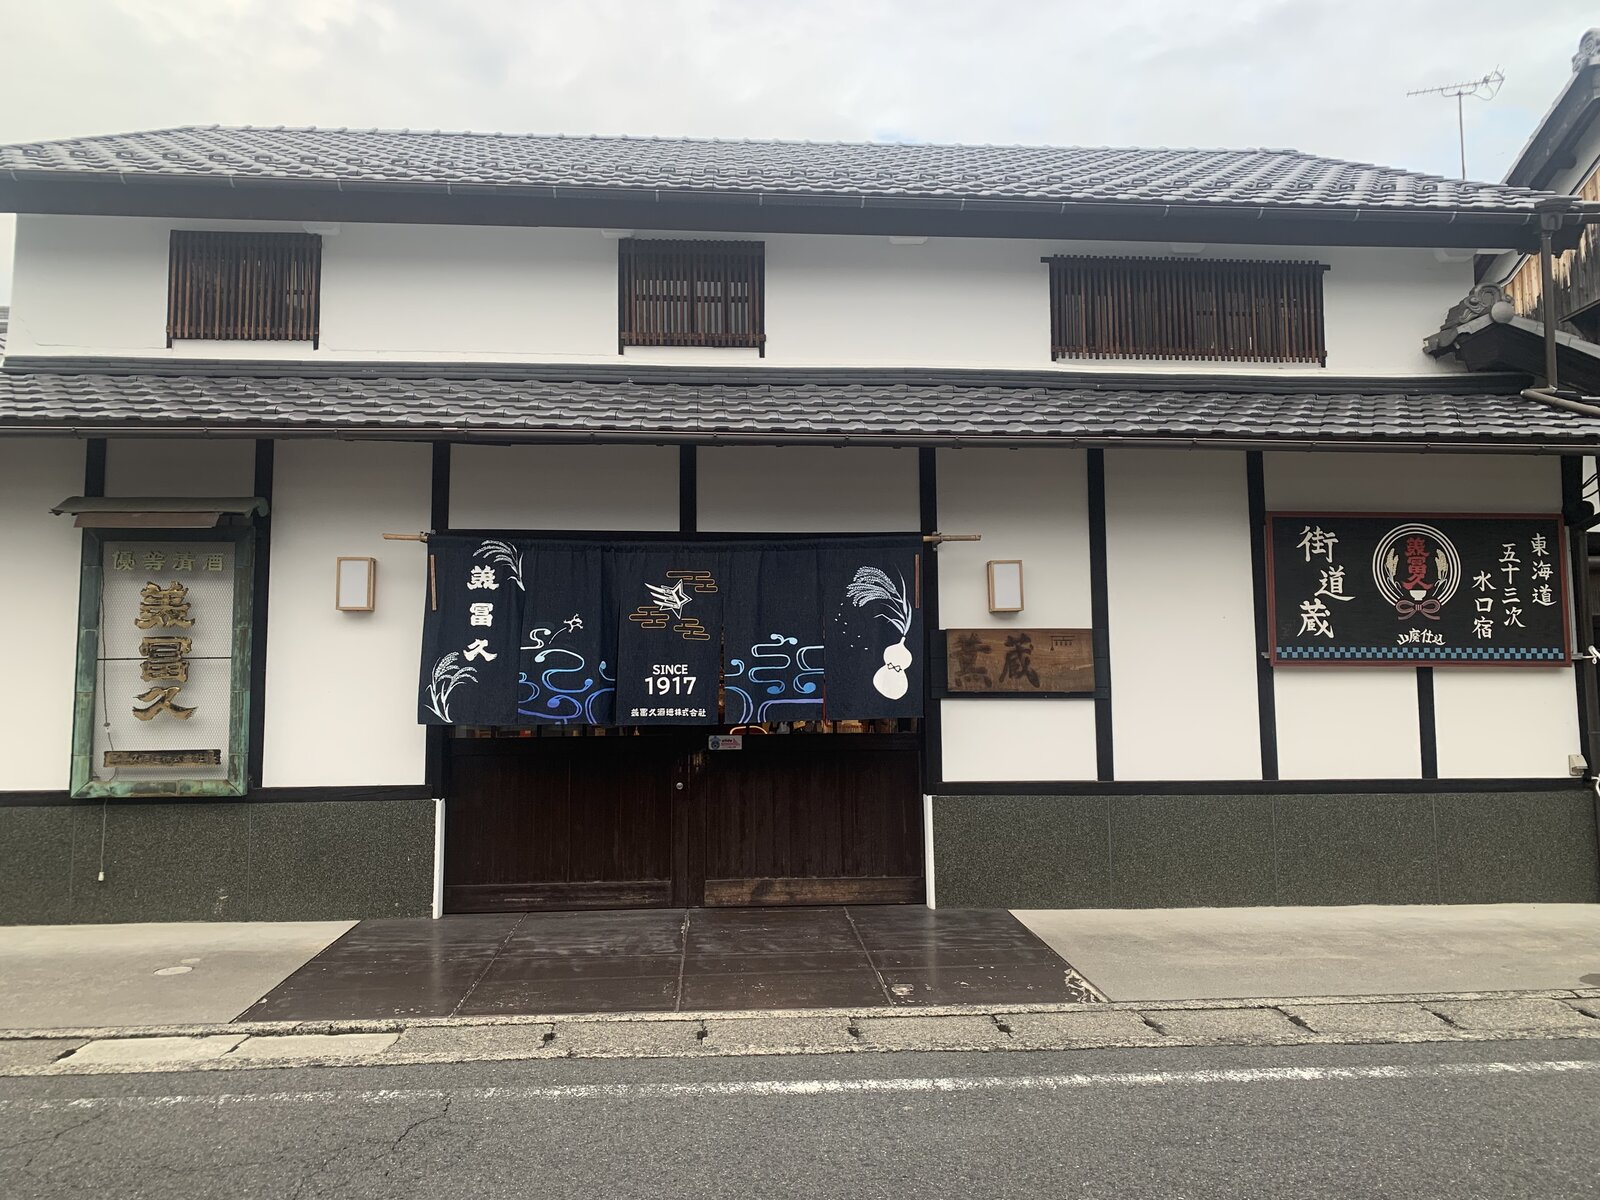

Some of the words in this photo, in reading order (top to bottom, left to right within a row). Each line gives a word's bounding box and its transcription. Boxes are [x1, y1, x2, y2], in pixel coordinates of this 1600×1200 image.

[111, 551, 225, 571] 優等清酒
[1295, 525, 1356, 639] 街道蔵
[1498, 542, 1527, 628] 五十三次
[1530, 532, 1557, 607] 東海道
[1471, 570, 1497, 639] 水口宿
[644, 676, 697, 695] 1917
[652, 664, 689, 675] SINCE
